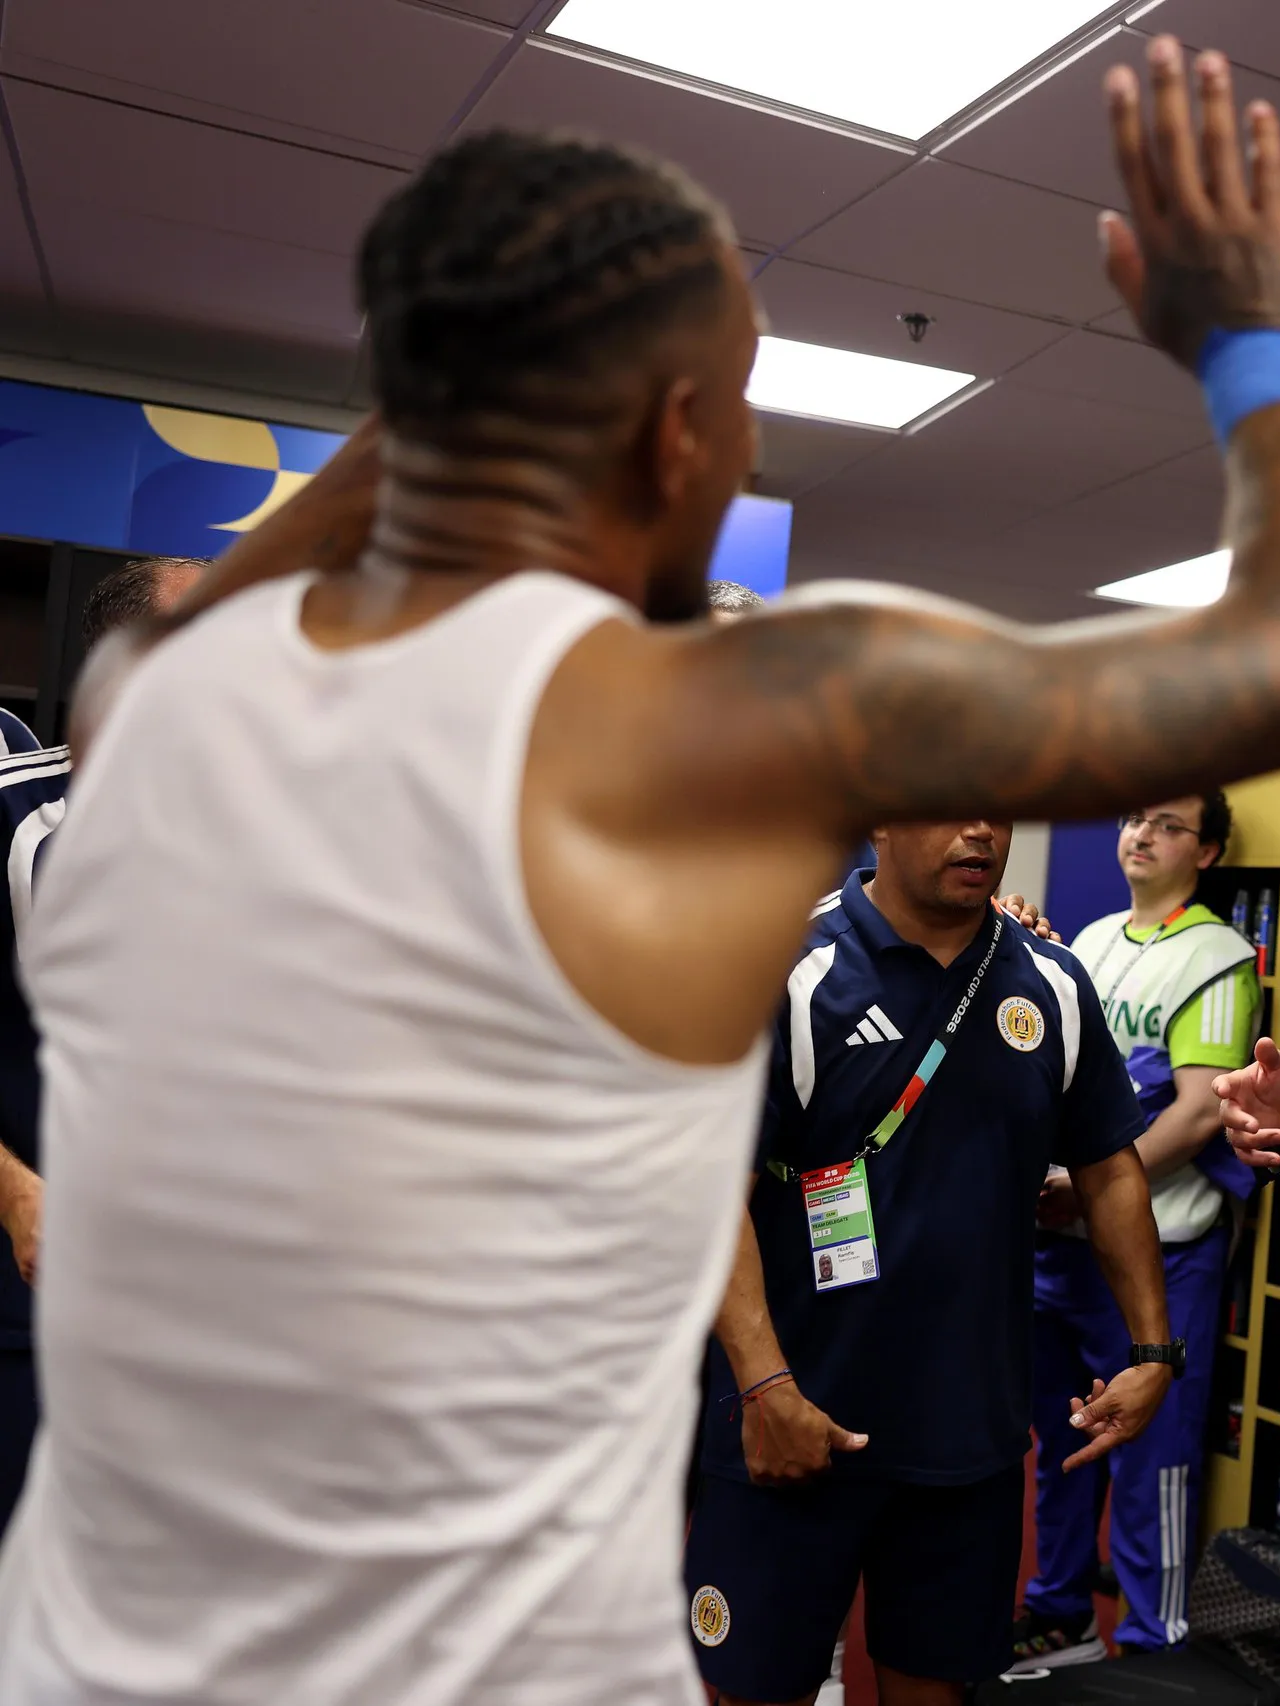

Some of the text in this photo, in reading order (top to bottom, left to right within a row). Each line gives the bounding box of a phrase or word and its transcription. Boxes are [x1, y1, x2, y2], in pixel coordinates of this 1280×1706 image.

[946, 919, 1003, 1033] FIFA WORLD CUP 2026
[805, 1182, 816, 1190] FIFA
[816, 1177, 833, 1187] WORLD
[833, 1175, 843, 1183] CUP
[812, 1216, 848, 1229] TEAM DELEGATE
